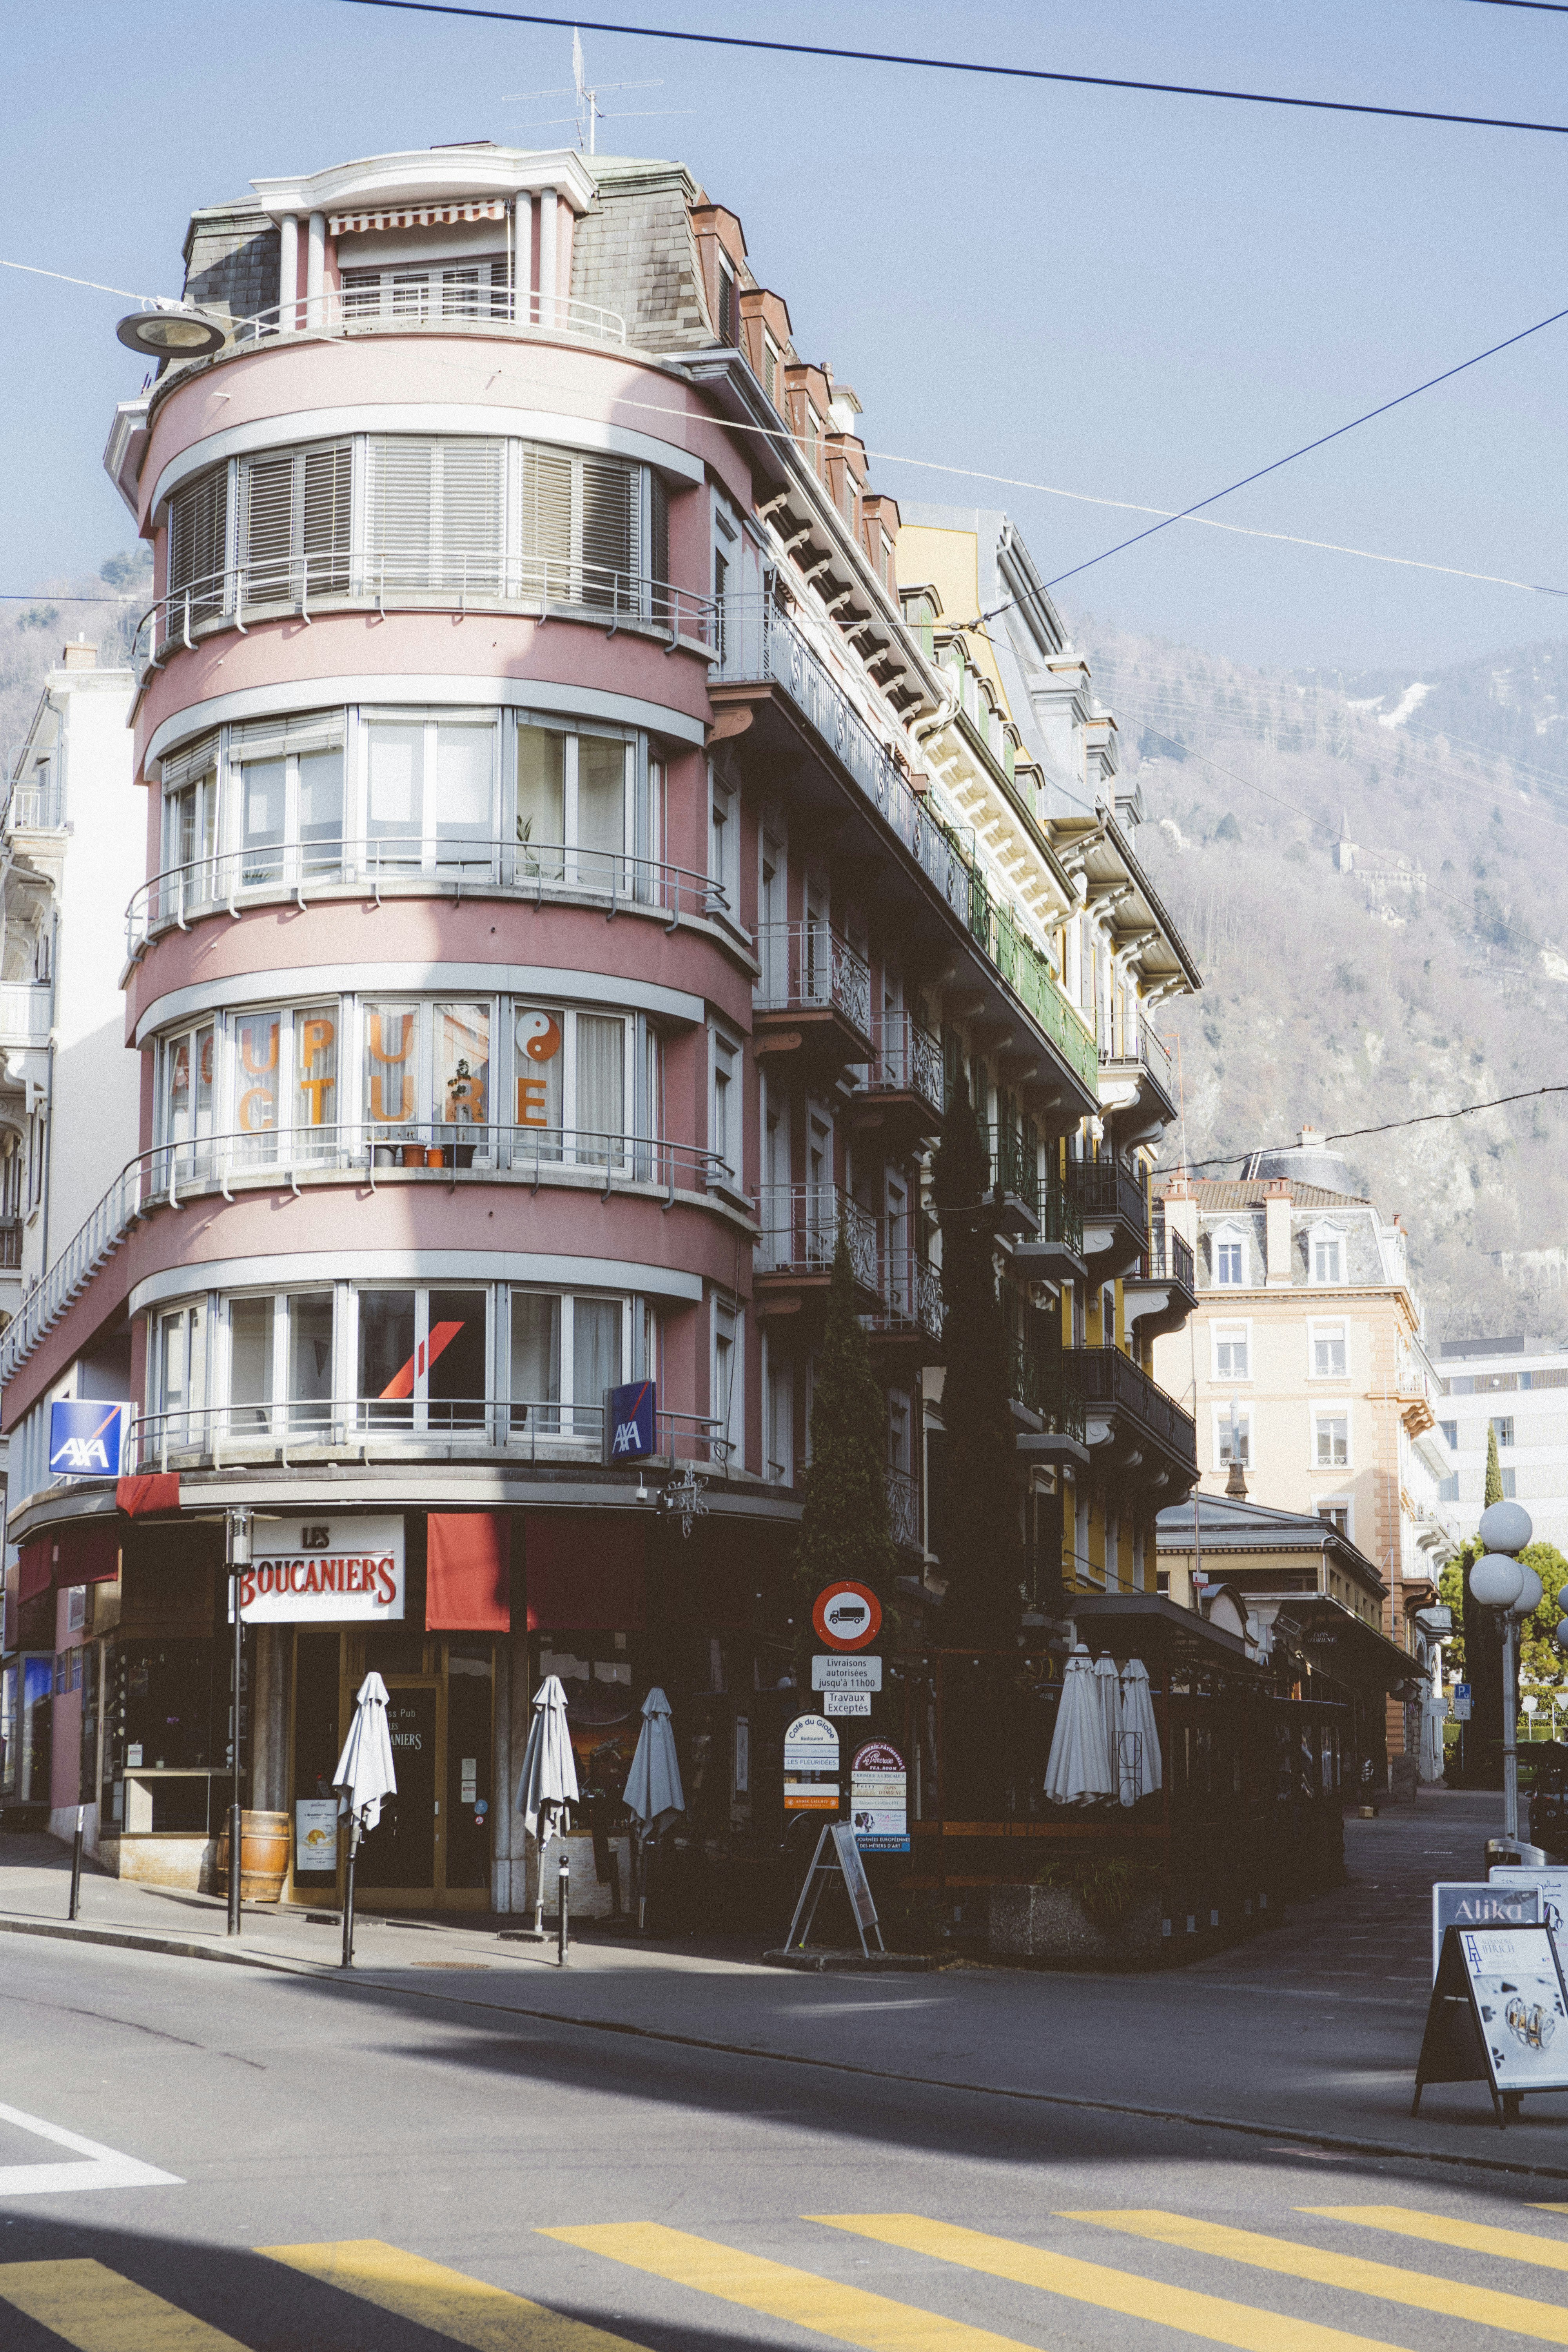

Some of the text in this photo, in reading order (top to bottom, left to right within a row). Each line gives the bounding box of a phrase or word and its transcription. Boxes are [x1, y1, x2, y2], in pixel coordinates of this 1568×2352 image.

[612, 1421, 642, 1454] AXA
[51, 1437, 109, 1468] AXA
[302, 1526, 330, 1549] LES
[240, 1557, 397, 1606] BOUCANIERS
[272, 1596, 333, 1606] Established
[827, 1659, 867, 1667] Livraisons
[818, 1679, 848, 1688] jusqu'à
[830, 1693, 865, 1702] Travaux
[1458, 1686, 1465, 1696] P
[400, 1708, 416, 1717] Pub
[828, 1703, 868, 1714] Exceptés
[789, 1721, 803, 1738] Café
[817, 1720, 835, 1738] Globe
[390, 1733, 422, 1750] ANIERS
[1455, 1899, 1523, 1920] Alika
